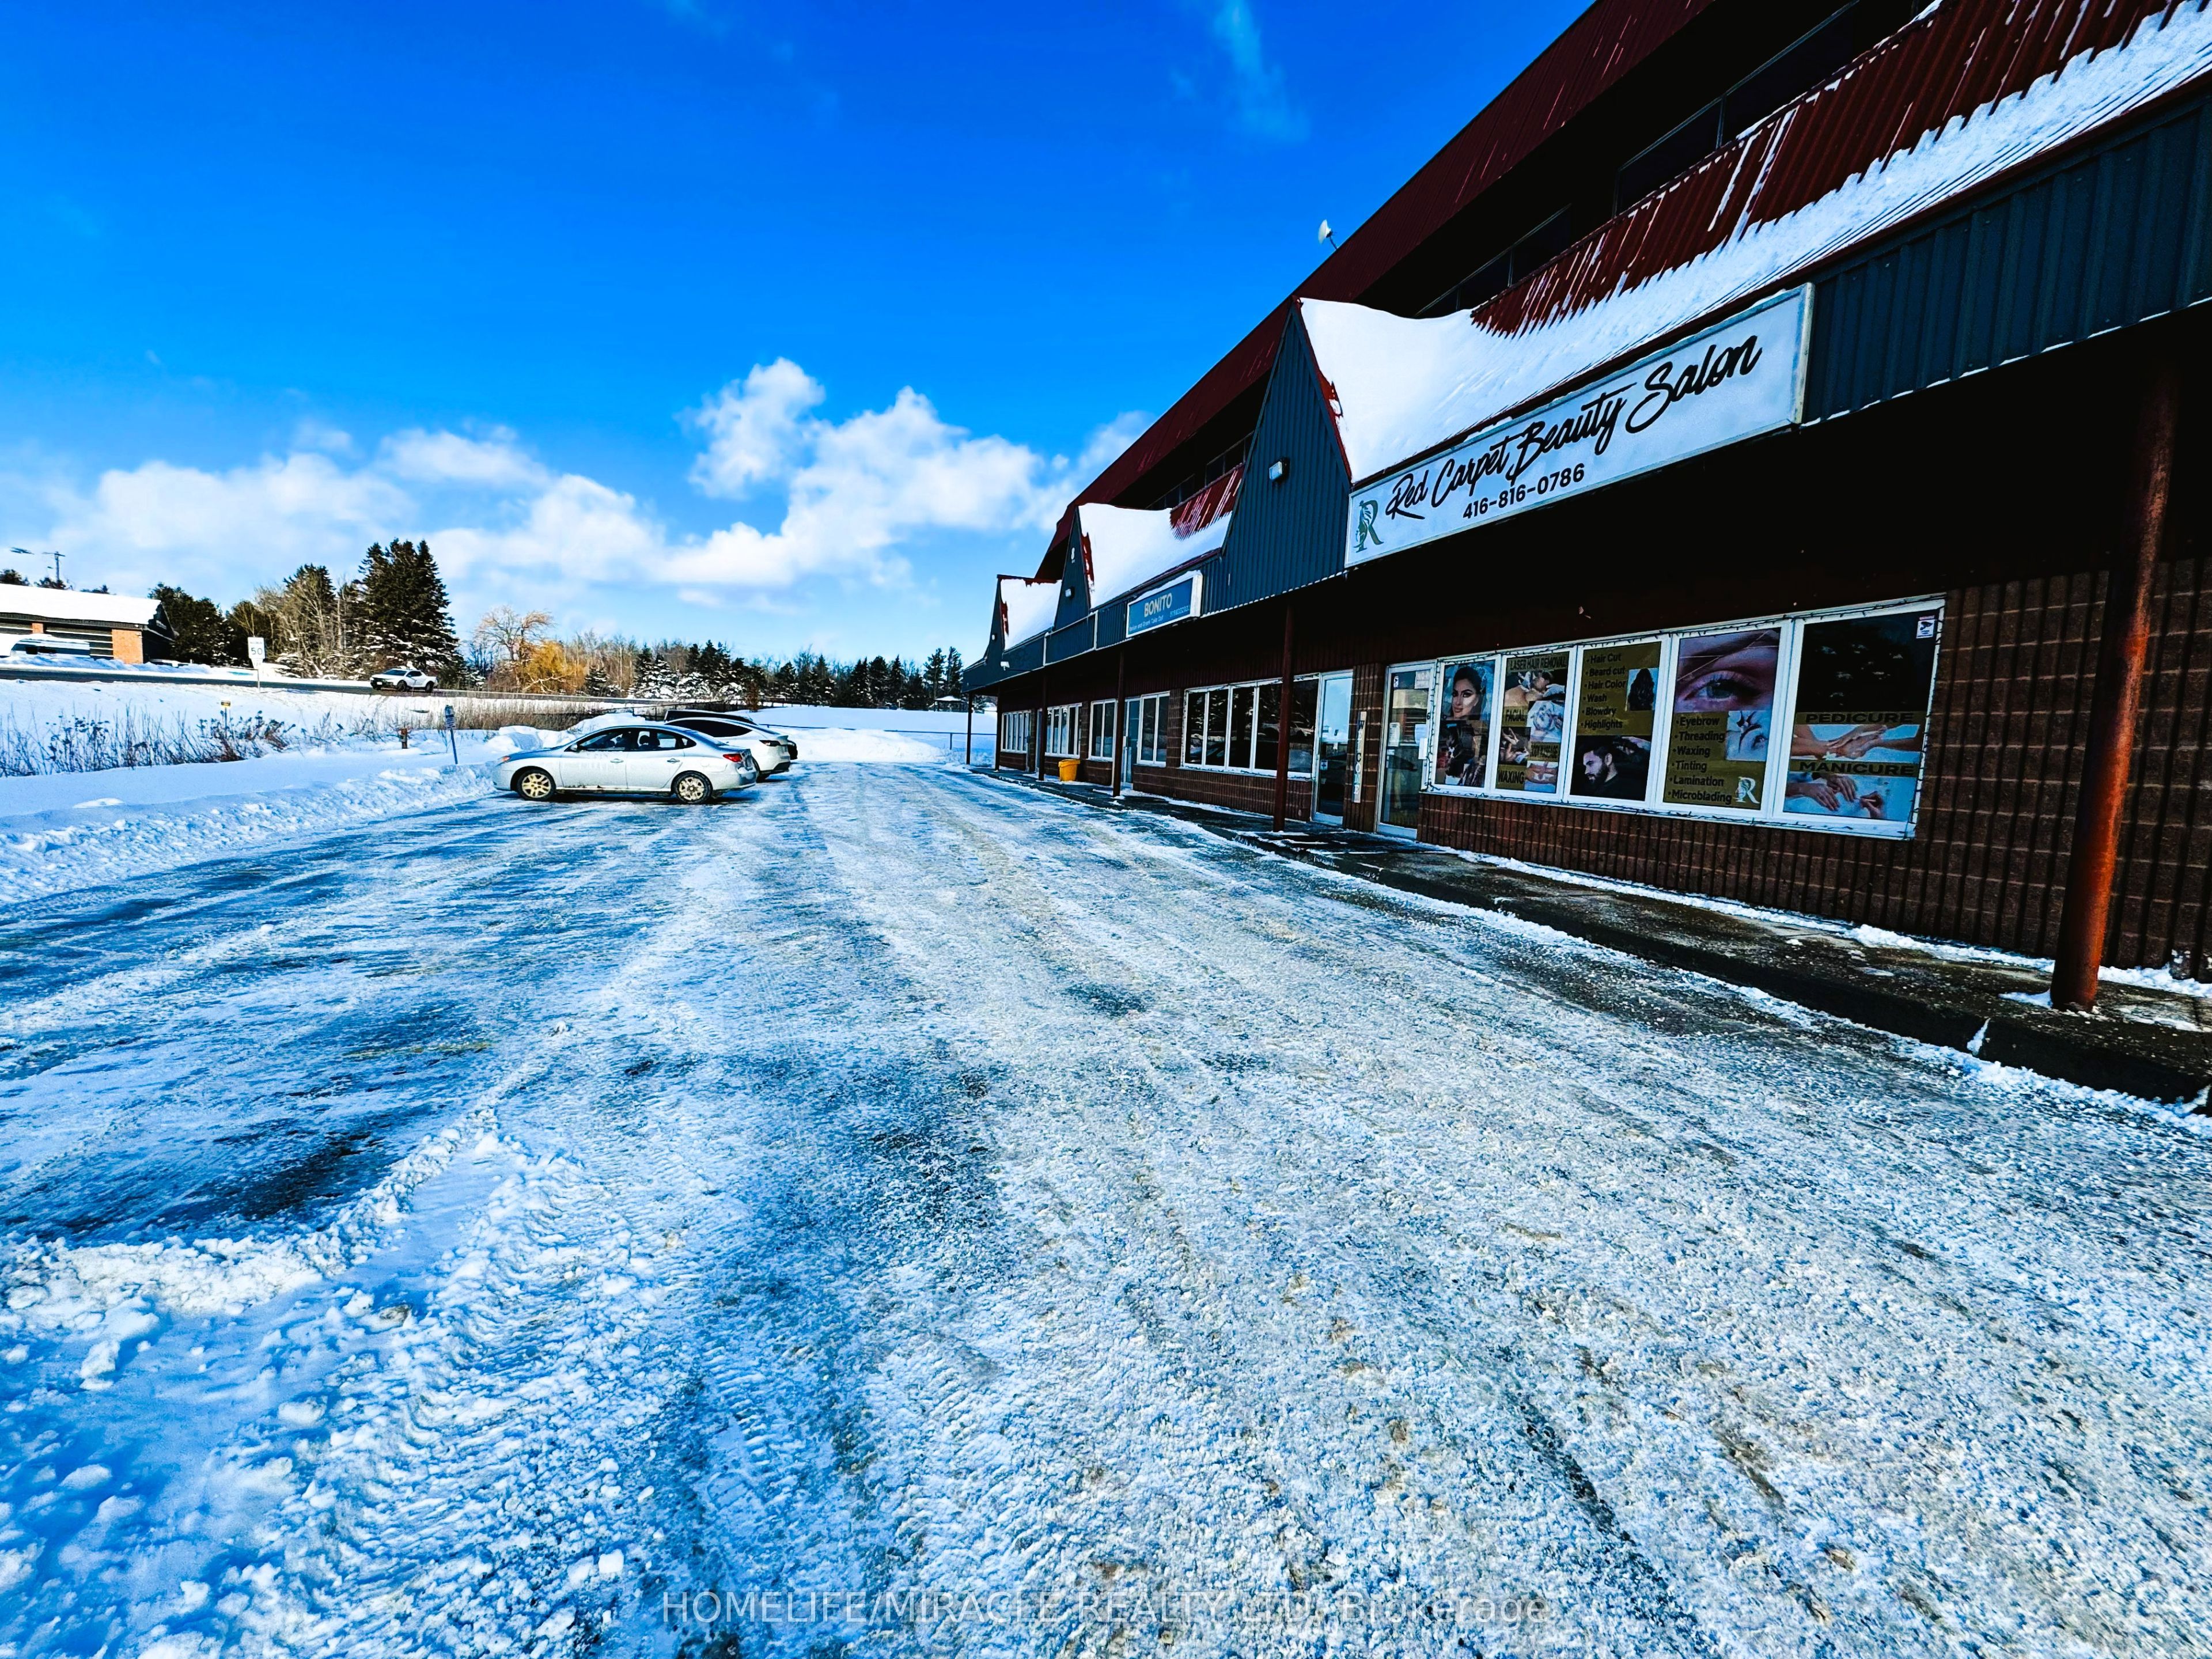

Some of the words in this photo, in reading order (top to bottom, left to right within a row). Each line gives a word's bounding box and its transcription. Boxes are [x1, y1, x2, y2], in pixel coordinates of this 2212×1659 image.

[1385, 470, 1429, 520] Red
[1431, 433, 1524, 507] Carpet
[1506, 382, 1637, 486] Beauty
[1626, 335, 1763, 433] Salon
[1464, 463, 1584, 519] 416-816-0786
[1143, 593, 1173, 618] BONITO
[251, 647, 263, 655] 50
[1510, 658, 1527, 670] LASER
[1527, 657, 1540, 669] HAIR
[1540, 656, 1566, 669] REMOVAL
[1590, 655, 1606, 664] Hair
[1607, 653, 1622, 662] Cut
[1589, 666, 1611, 677] Beard
[1588, 680, 1603, 690] Hair
[1605, 680, 1626, 688] Color
[1587, 693, 1607, 702] Wash
[1505, 710, 1526, 721] FACIAL
[1585, 706, 1617, 717] Blowdry
[1680, 717, 1719, 728] Eyebrow
[1805, 713, 1914, 724] PEDICURE
[1584, 719, 1623, 730] Highlights
[1679, 730, 1725, 743] Threading
[1677, 746, 1710, 757] Waxing
[1676, 760, 1707, 772] Tinting
[1799, 762, 1915, 775] MANICURE
[1498, 770, 1525, 784] WAXING
[1673, 775, 1724, 787] Lamination
[1672, 789, 1732, 805] Microblading
